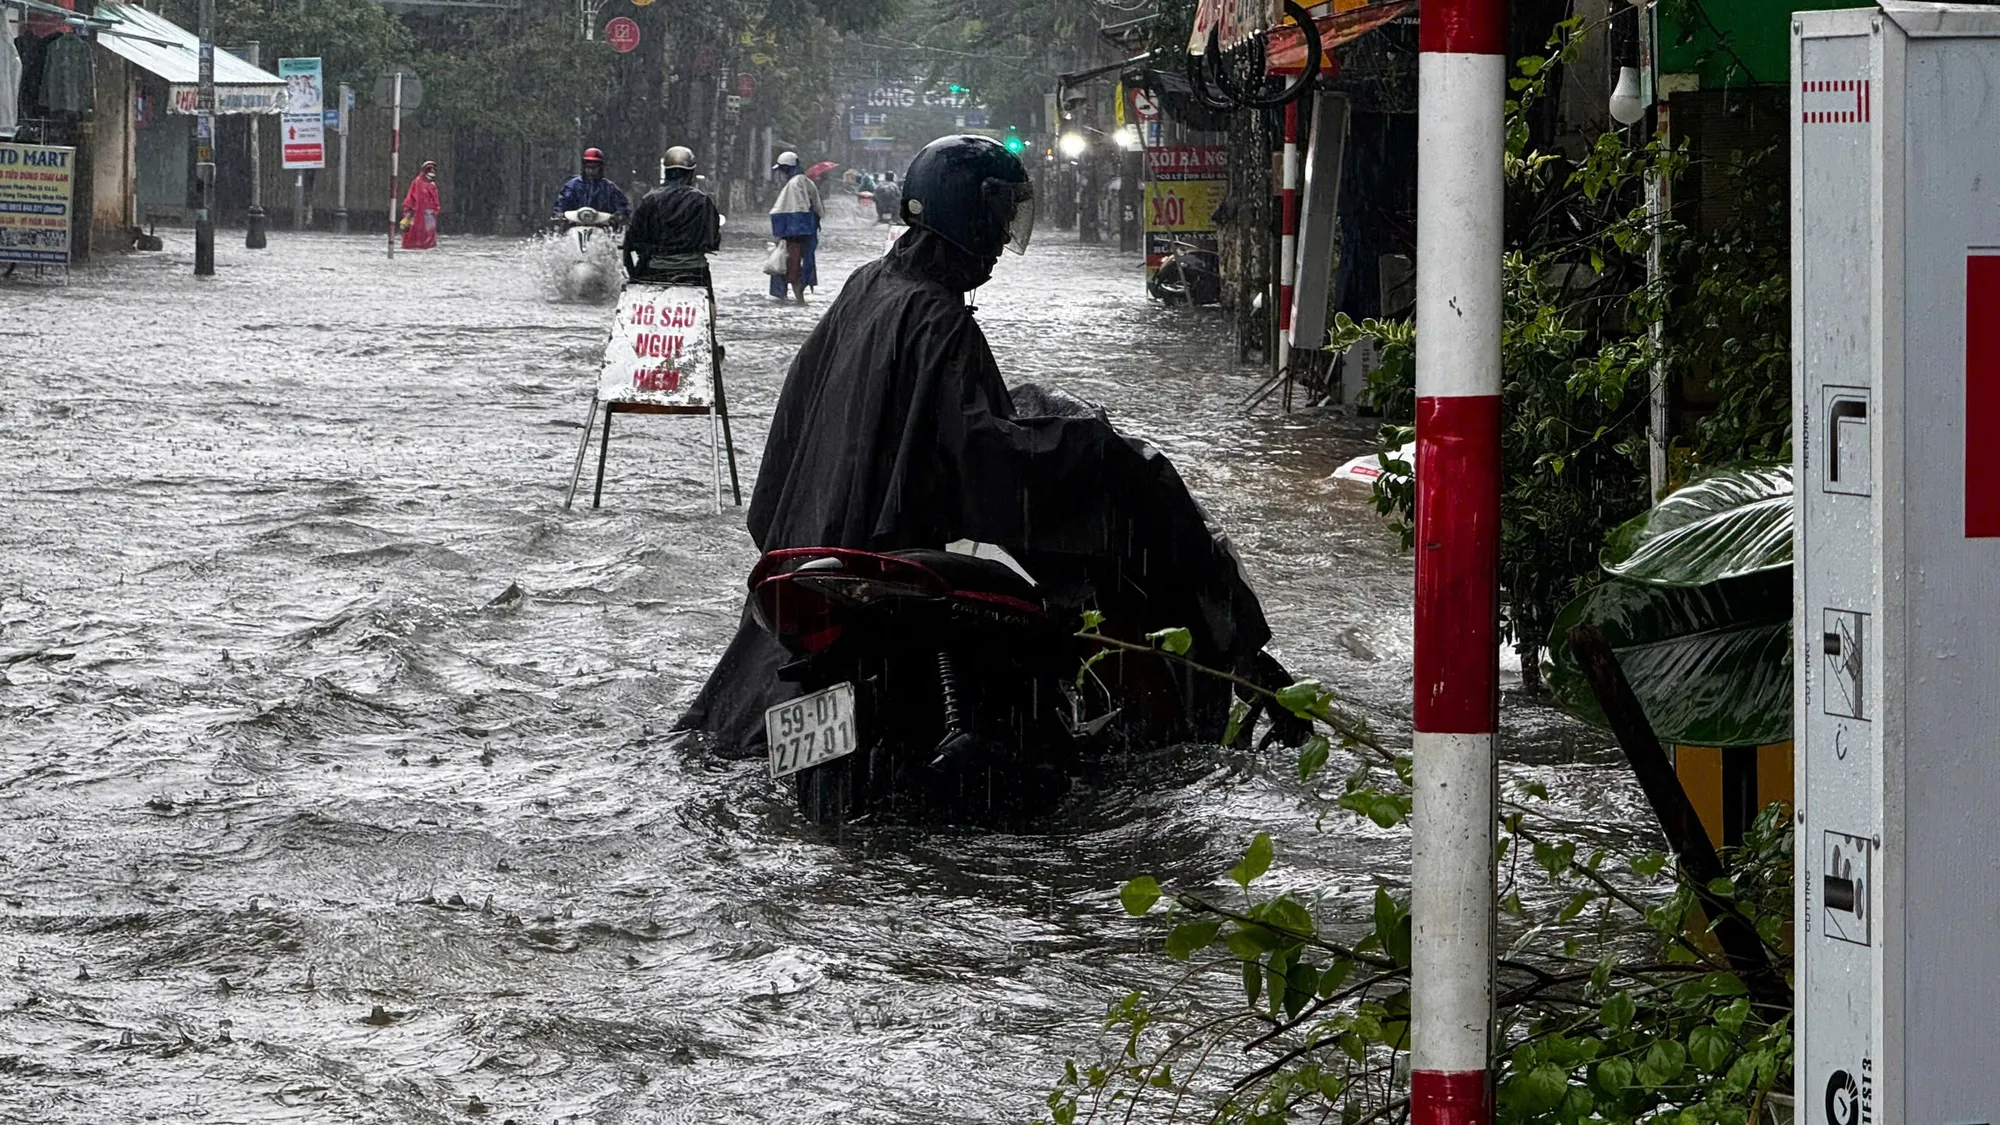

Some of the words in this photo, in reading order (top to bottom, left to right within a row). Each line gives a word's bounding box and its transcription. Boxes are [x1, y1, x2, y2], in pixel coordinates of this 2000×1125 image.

[868, 88, 915, 107] LONG
[23, 150, 69, 168] MART
[1149, 148, 1175, 166] XÔI
[1180, 148, 1199, 166] BÀ
[1151, 188, 1185, 226] XÔI
[636, 333, 684, 358] NGUY
[776, 721, 848, 773] 277.01
